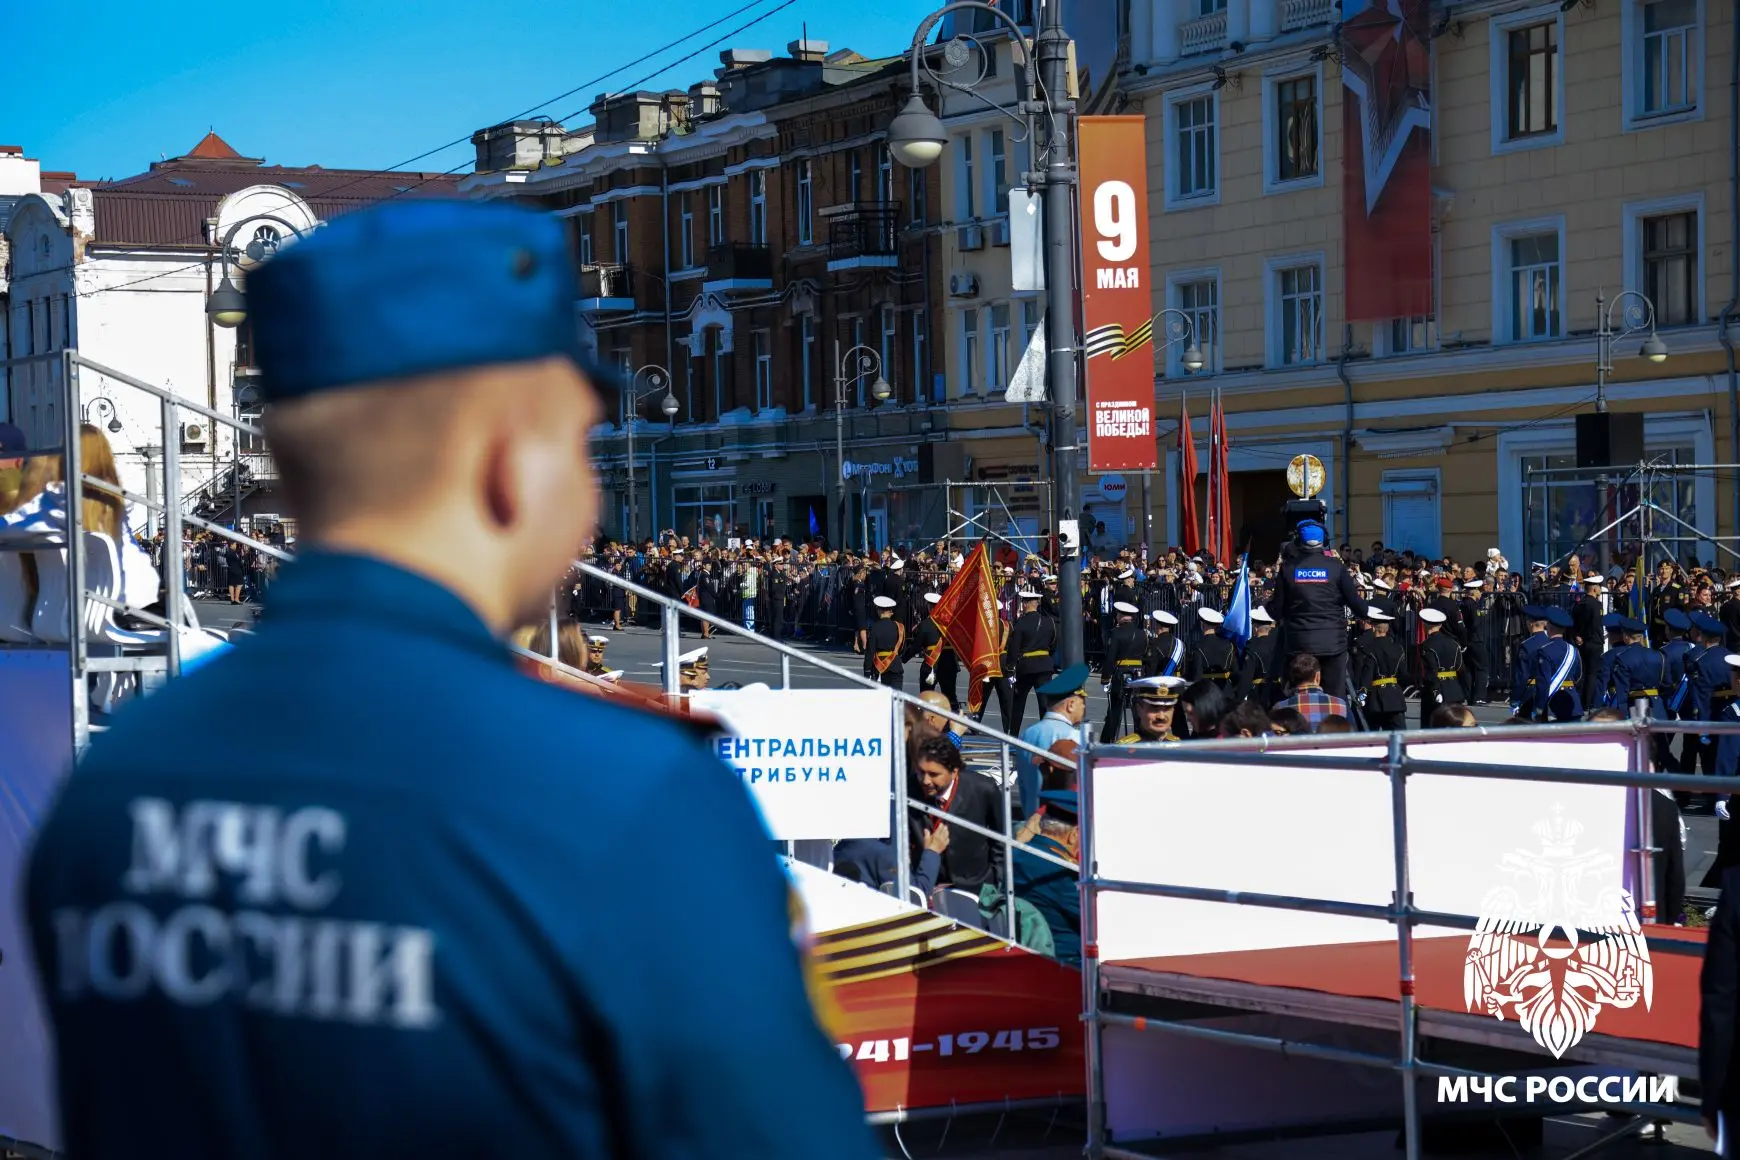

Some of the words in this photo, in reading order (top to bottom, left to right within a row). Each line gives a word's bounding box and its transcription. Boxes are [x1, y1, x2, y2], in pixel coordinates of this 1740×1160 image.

[1093, 180, 1137, 262] 9
[1096, 267, 1139, 289] МАЯ
[1096, 408, 1150, 423] ВЕЛИКОЙ
[1096, 423, 1150, 438] ПОБЕДЫ!
[1297, 570, 1327, 578] РОССИЯ
[717, 738, 882, 759] ЕНТРАЛЬНАЯ
[734, 767, 847, 783] ТРИБУНА
[124, 797, 346, 908] МЧС
[834, 1027, 1060, 1062] 41-1945
